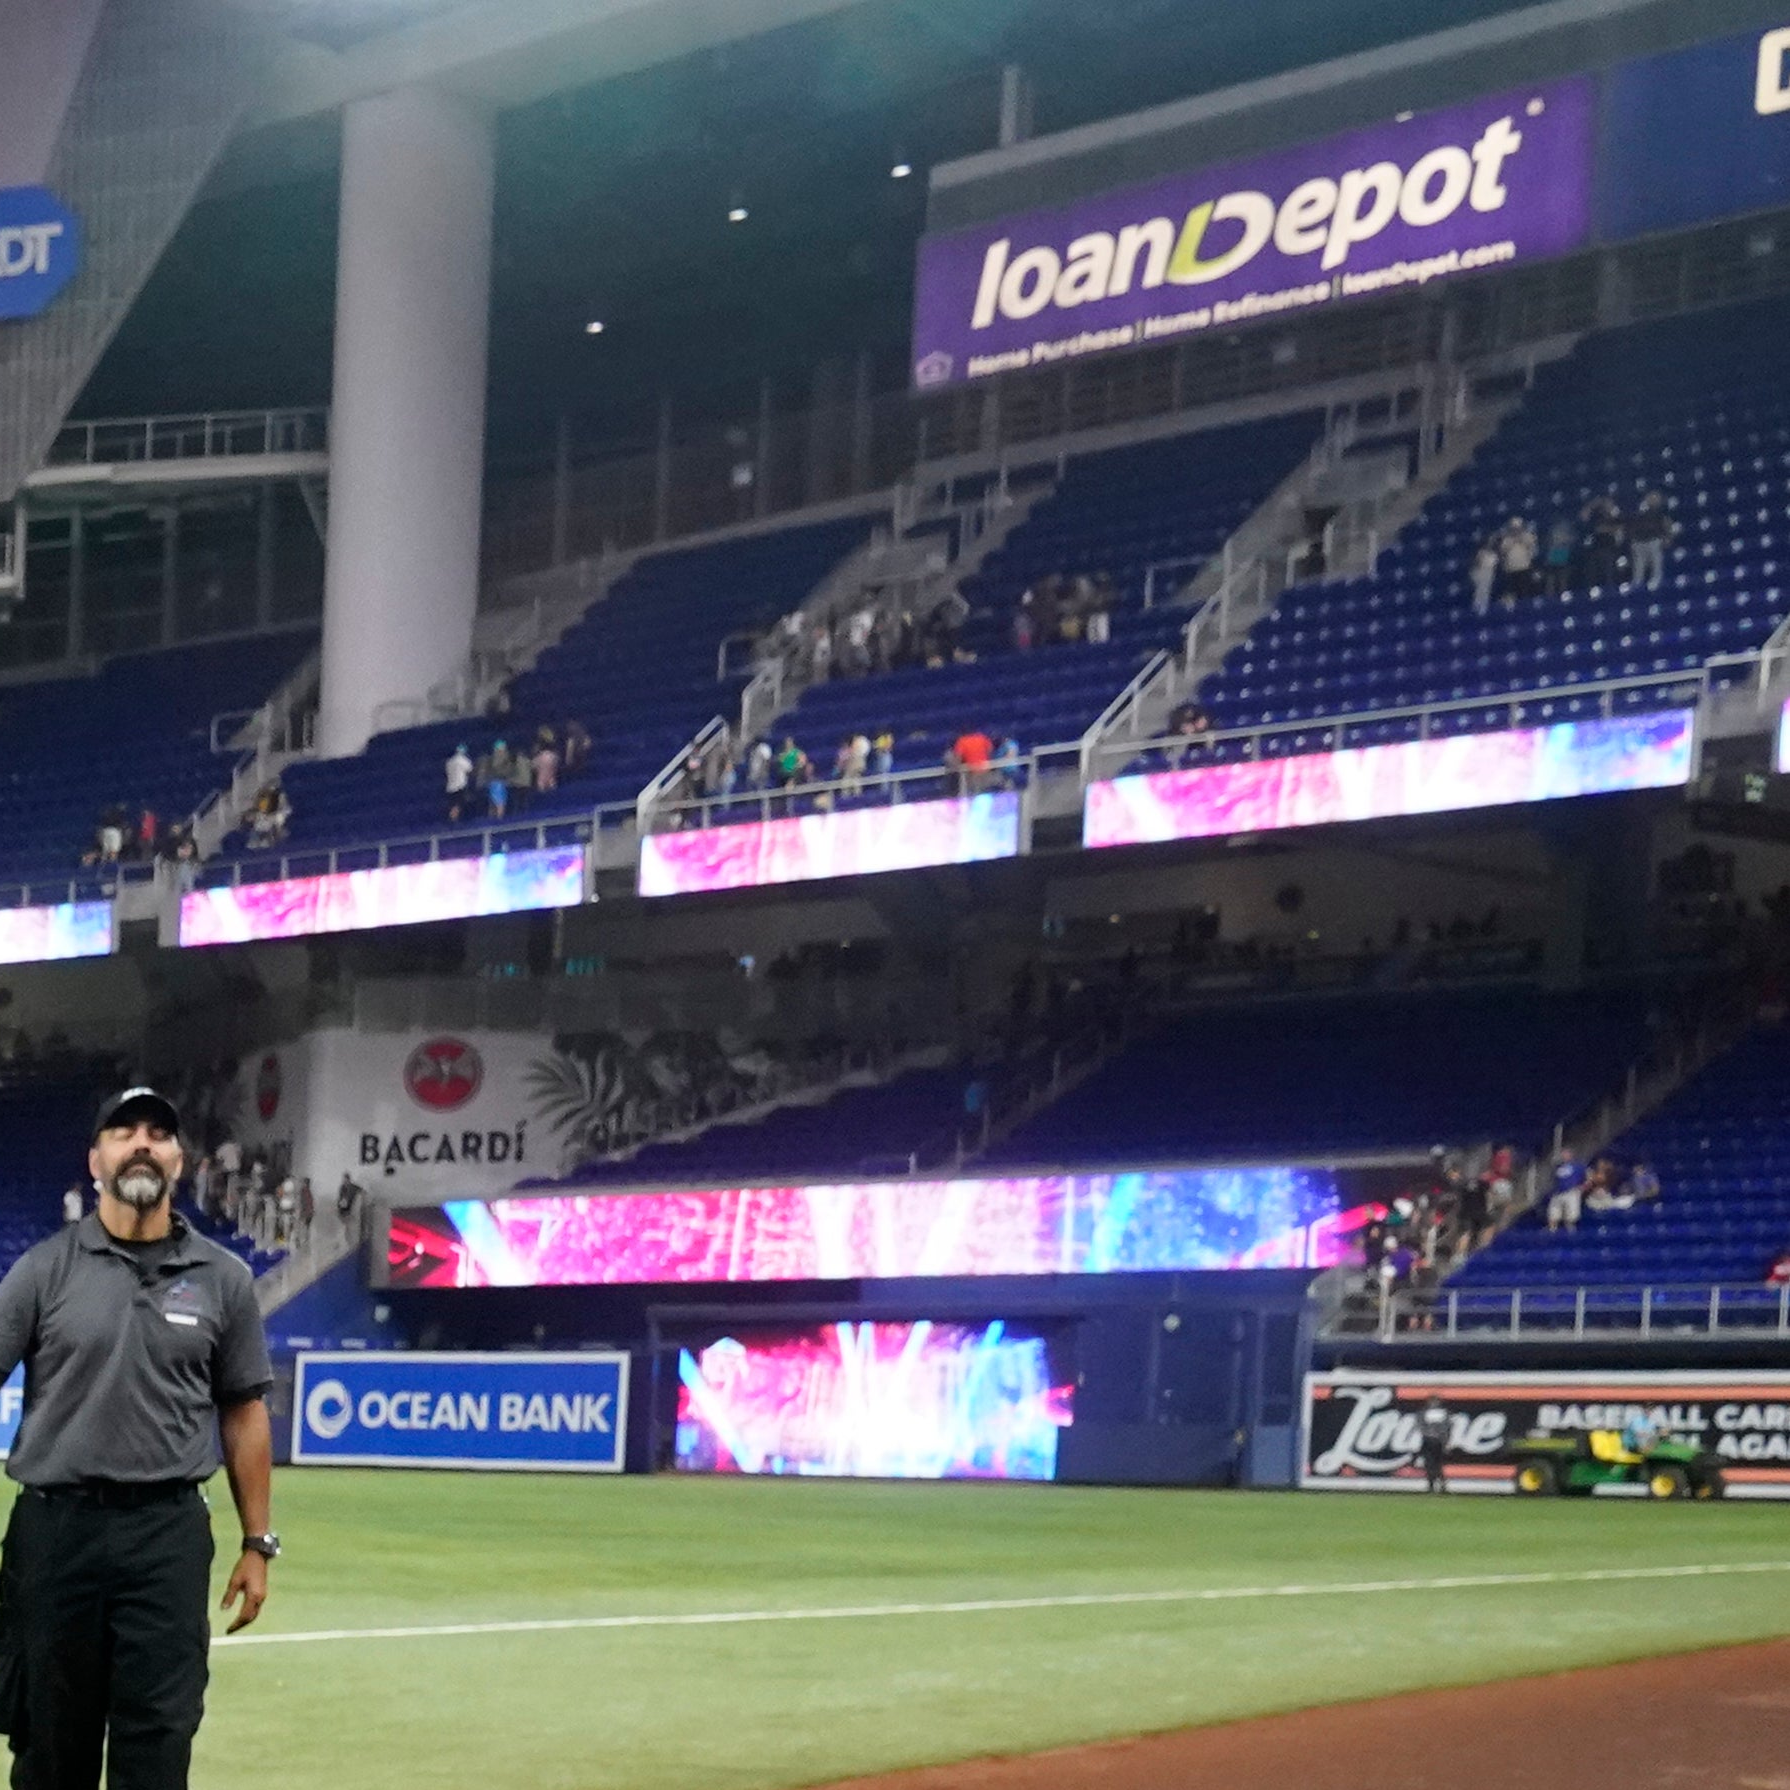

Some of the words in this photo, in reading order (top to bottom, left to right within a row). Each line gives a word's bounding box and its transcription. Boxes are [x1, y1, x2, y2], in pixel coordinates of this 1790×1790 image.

[971, 116, 1521, 330] loanDepot
[357, 1389, 489, 1432] OCEAN
[499, 1392, 612, 1433] BANK
[1716, 1432, 1790, 1460] AGA
